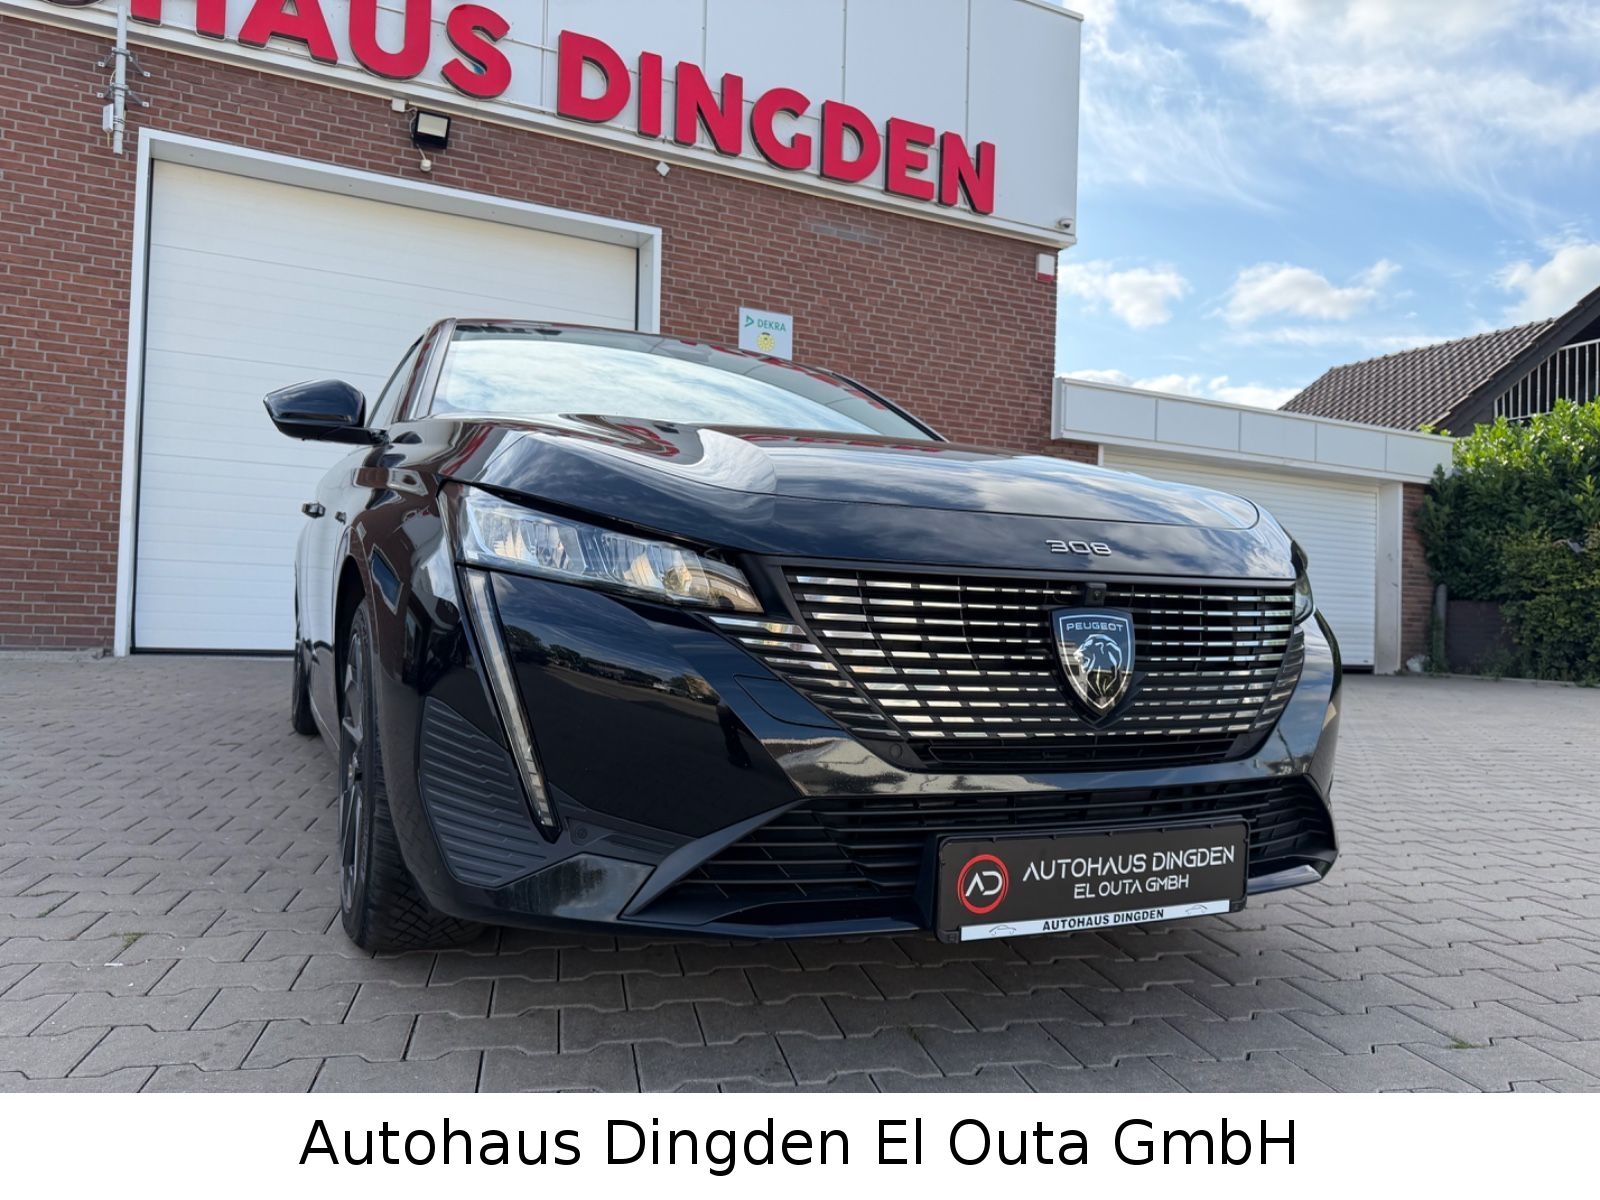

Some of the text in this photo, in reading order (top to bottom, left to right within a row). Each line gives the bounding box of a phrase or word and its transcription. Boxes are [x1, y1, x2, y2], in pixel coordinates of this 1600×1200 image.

[45, 0, 996, 215] AUS DINGDEN
[757, 318, 787, 332] DEKRA
[1046, 539, 1112, 556] 308
[1066, 621, 1124, 632] PEUGEOT
[1022, 844, 1236, 882] AUTOHAUS DINGDEN
[965, 870, 1004, 897] AD
[1073, 873, 1190, 900] EL OUTA GMBH
[1042, 908, 1165, 932] AUTOHAUS DINGDEN
